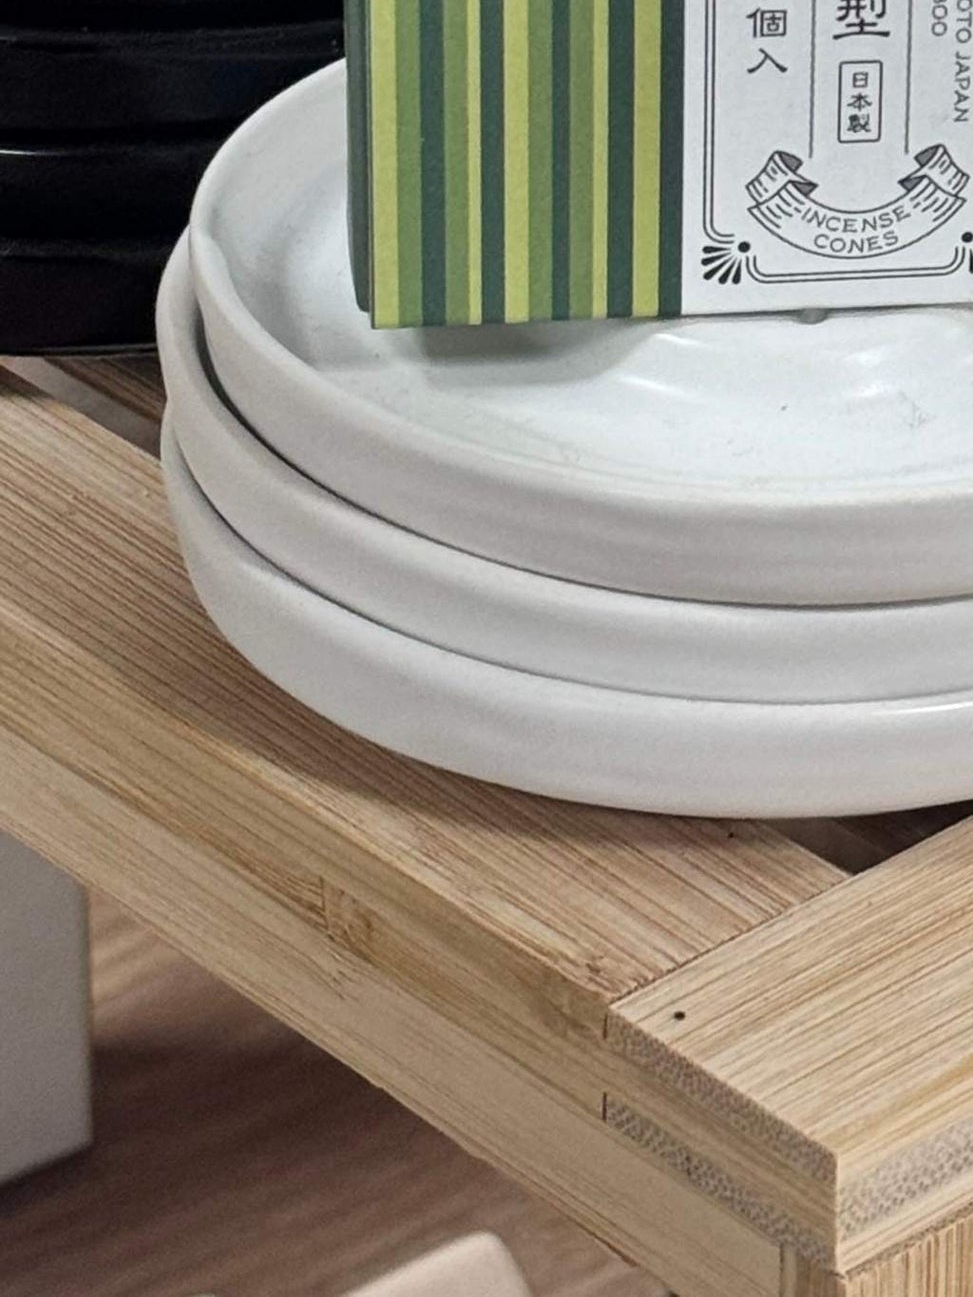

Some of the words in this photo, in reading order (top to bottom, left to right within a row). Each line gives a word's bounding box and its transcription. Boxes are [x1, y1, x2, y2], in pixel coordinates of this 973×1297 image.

[846, 71, 873, 134] 日本製
[952, 51, 973, 123] JAPAN
[799, 204, 912, 233] INCENSE
[813, 230, 901, 253] CONES
